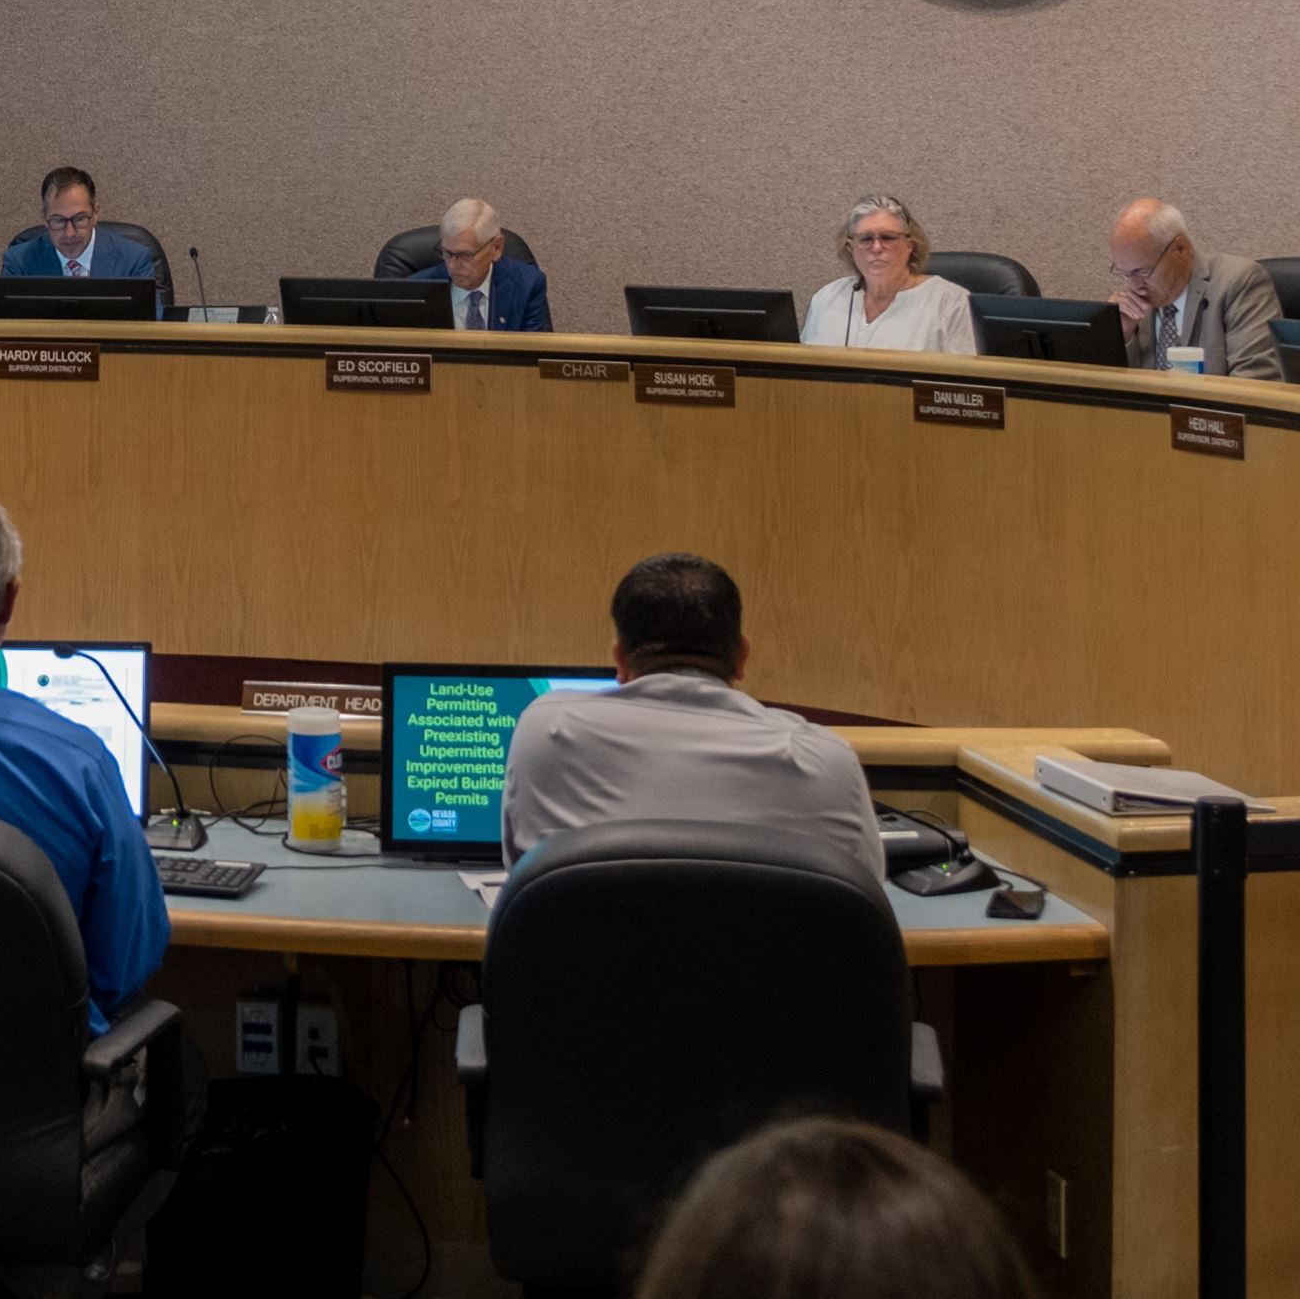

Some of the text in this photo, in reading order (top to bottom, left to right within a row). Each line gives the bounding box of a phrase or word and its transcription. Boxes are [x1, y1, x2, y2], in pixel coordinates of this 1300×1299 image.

[0, 350, 92, 363] HARDY BULLOCK
[48, 365, 77, 373] DISTRICT
[337, 360, 420, 374] ED SCOFIELD
[561, 363, 608, 379] CHAIR
[382, 375, 415, 385] DISTRICT
[654, 372, 716, 387] SUSAN HOEK
[933, 390, 984, 407] DAN MILLER
[430, 682, 494, 696] Land-Use
[252, 692, 382, 712] DEPARTMENT HEAD
[426, 697, 497, 714] Permitting
[407, 713, 516, 728] Associated with
[424, 728, 500, 746] Preexisting
[419, 744, 504, 760] Unpermitted
[406, 759, 505, 775] Improvements
[407, 775, 458, 792] Expired
[435, 791, 489, 806] Permits
